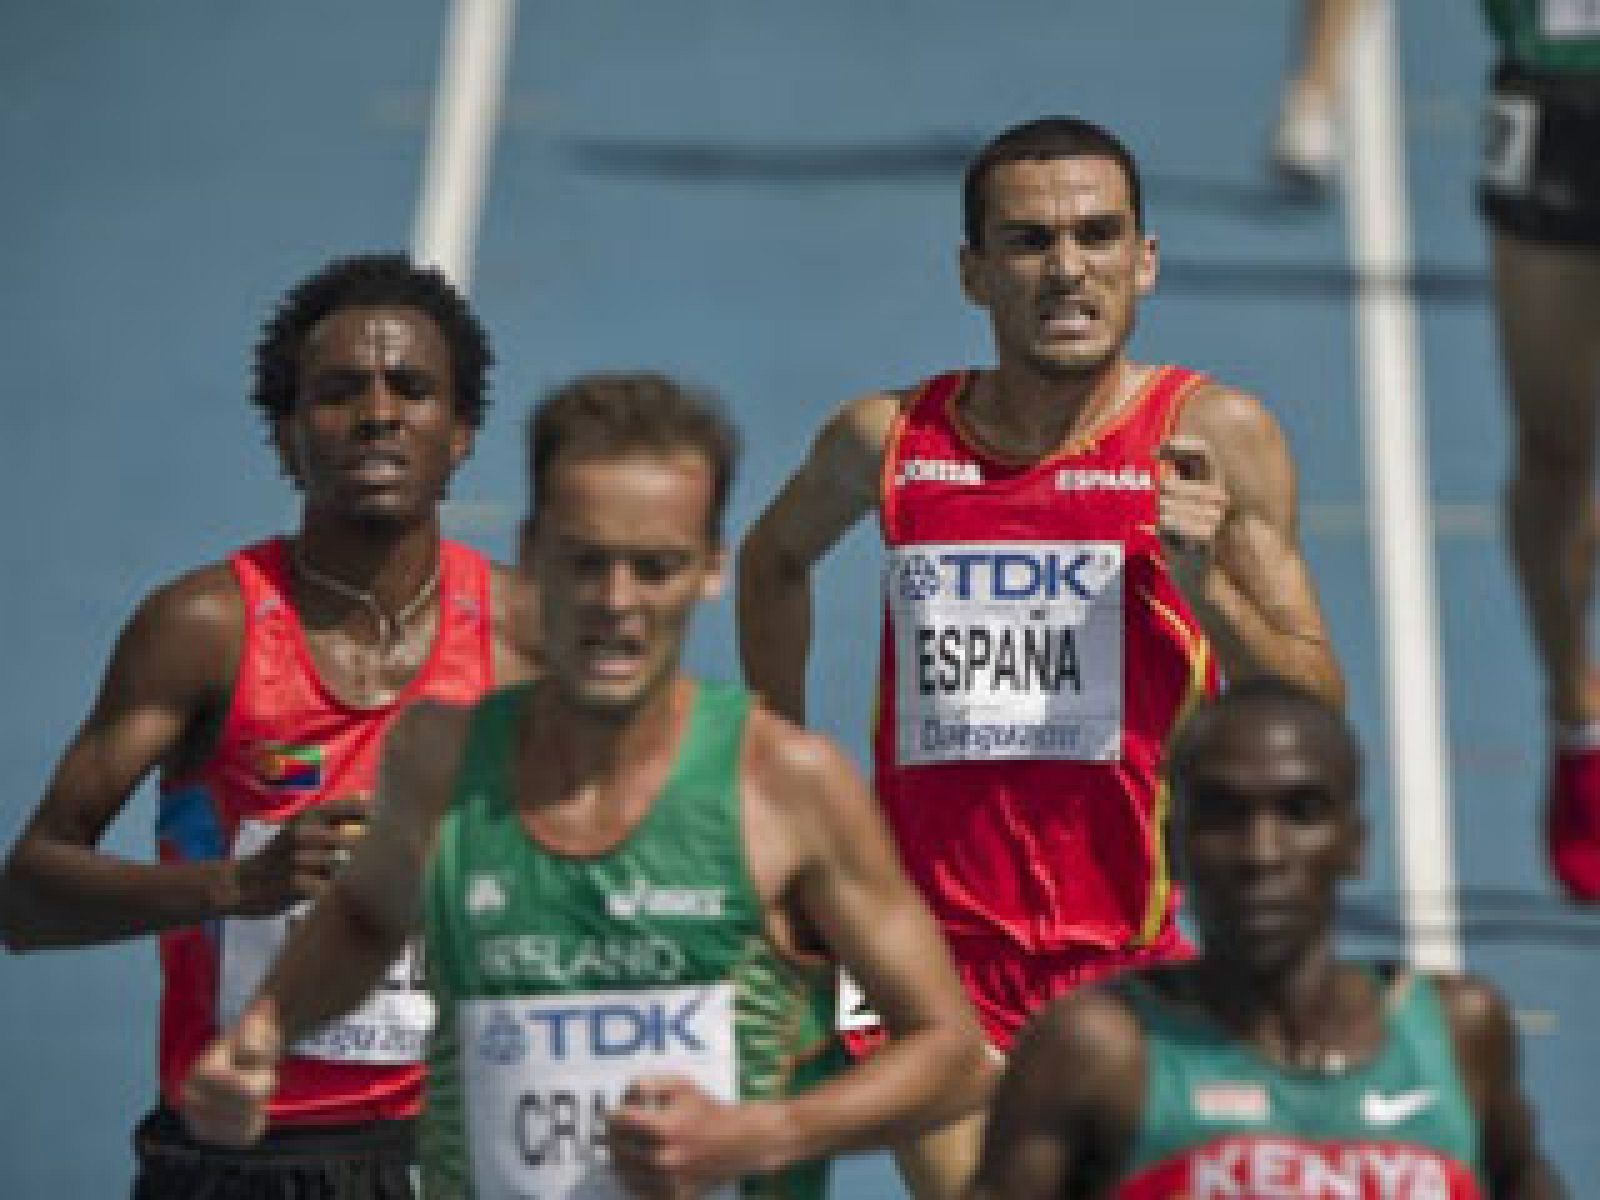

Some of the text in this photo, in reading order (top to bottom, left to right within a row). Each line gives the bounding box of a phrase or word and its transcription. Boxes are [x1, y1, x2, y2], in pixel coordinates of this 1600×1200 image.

[940, 553, 1093, 601] TDK
[918, 609, 1081, 695] ESPAÑA
[529, 1001, 706, 1060] TDK
[514, 1090, 608, 1168] CRA
[1192, 1140, 1446, 1200] KENYA
